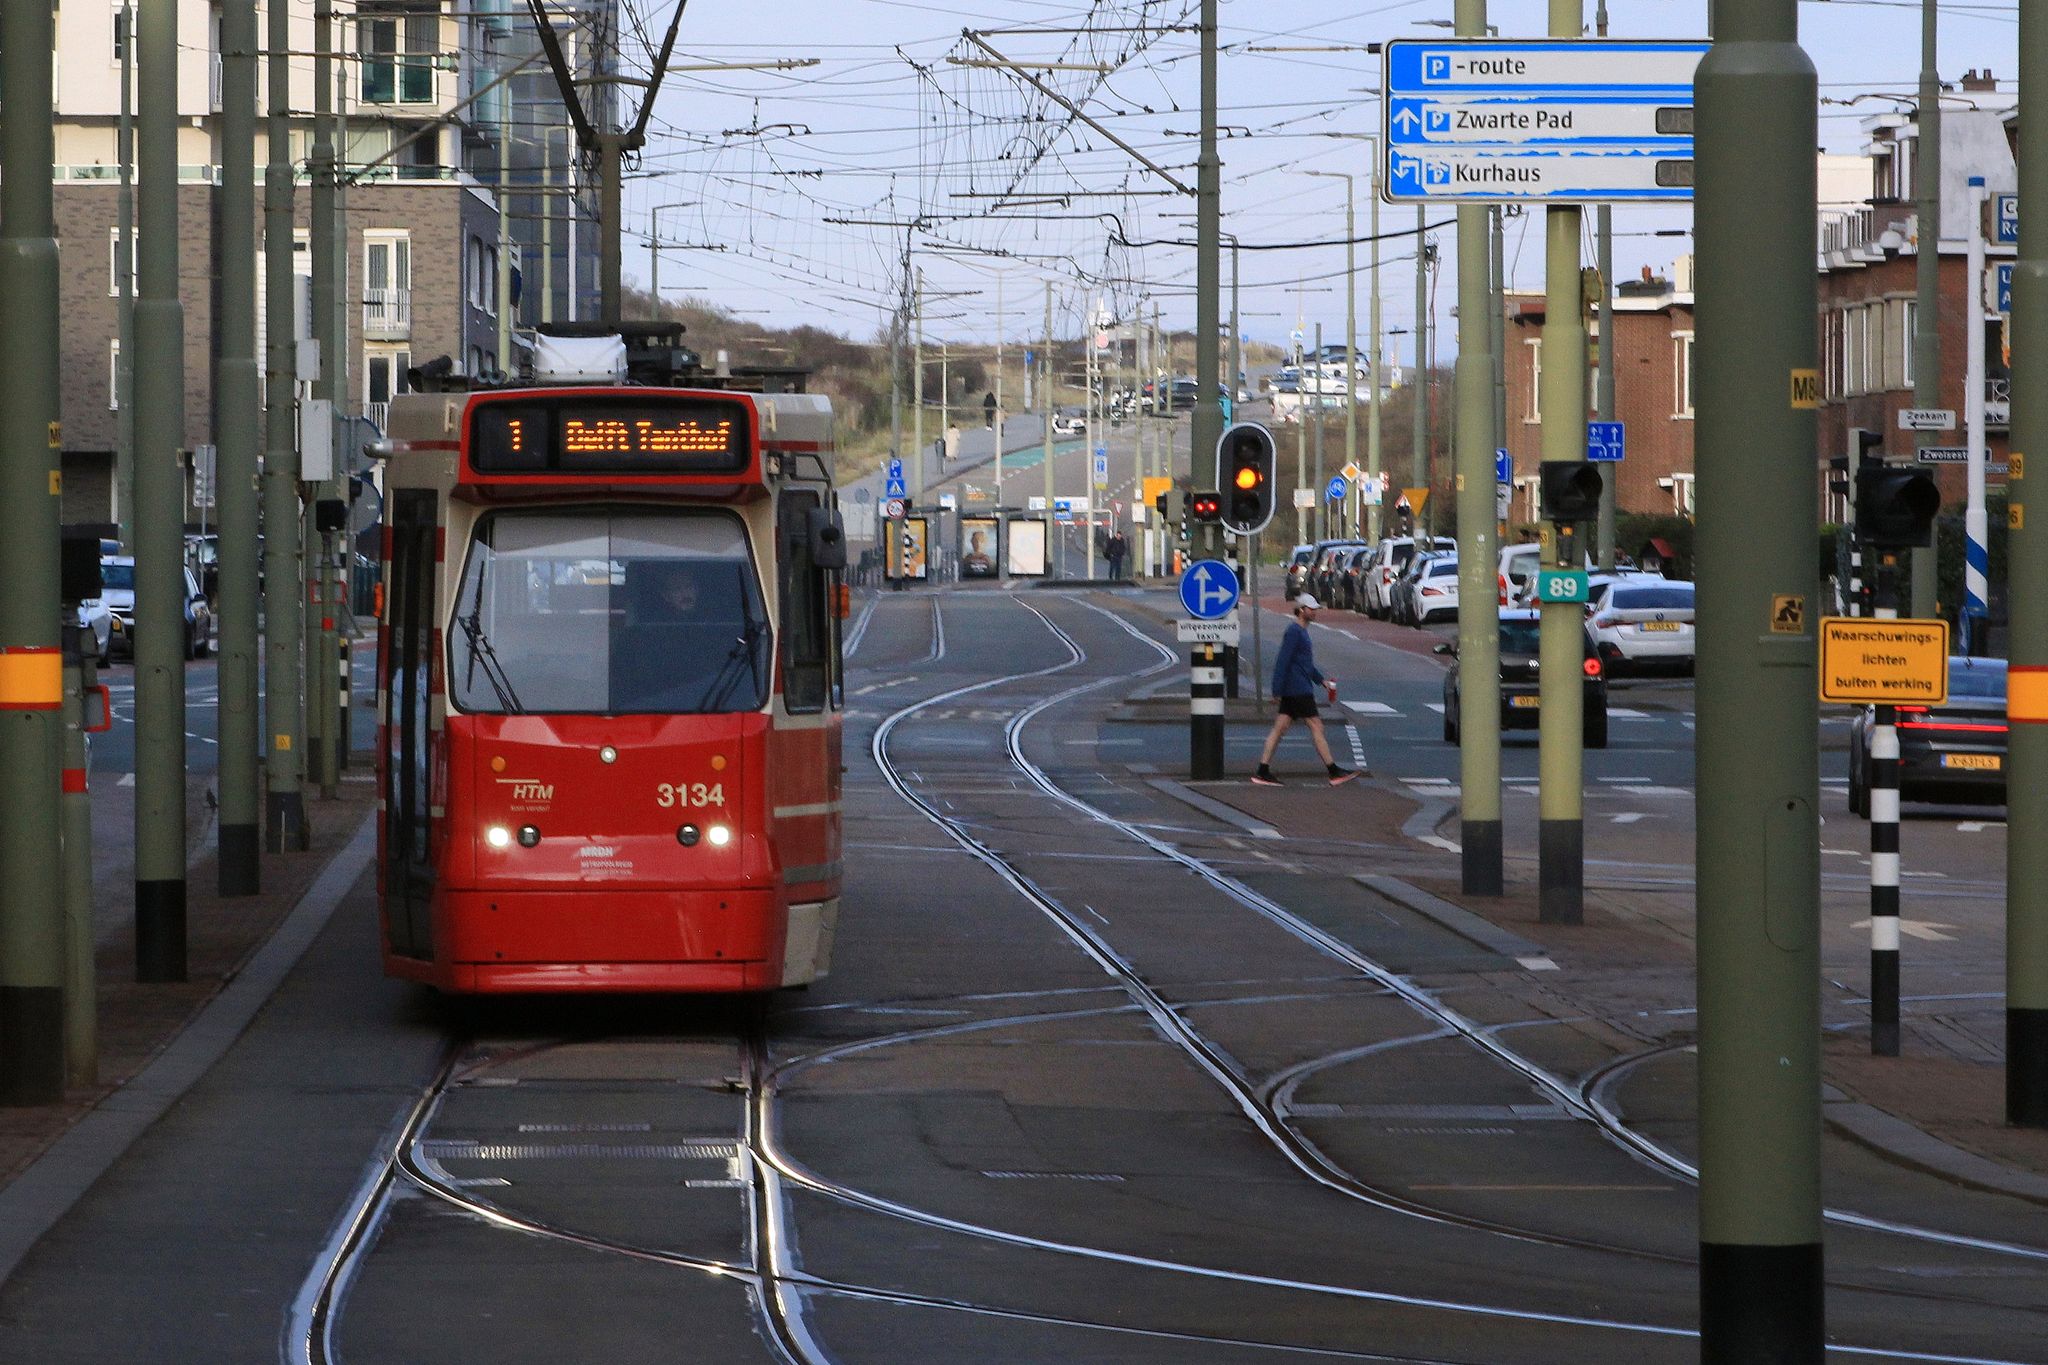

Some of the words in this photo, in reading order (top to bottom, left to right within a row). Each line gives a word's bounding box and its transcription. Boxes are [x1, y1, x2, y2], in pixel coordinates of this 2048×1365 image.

[1456, 110, 1530, 129] Zwarte
[1536, 110, 1573, 129] Pad
[1456, 163, 1541, 182] Kurhaus
[1906, 411, 1948, 421] Zeekant
[509, 421, 521, 450] 1
[1549, 577, 1578, 598] 89
[1831, 629, 1939, 647] Waarschuwings-
[1862, 653, 1907, 666] lichten
[1836, 676, 1876, 689] buiten
[1881, 678, 1932, 692] werking
[513, 784, 554, 799] HTM
[657, 782, 725, 809] 3134
